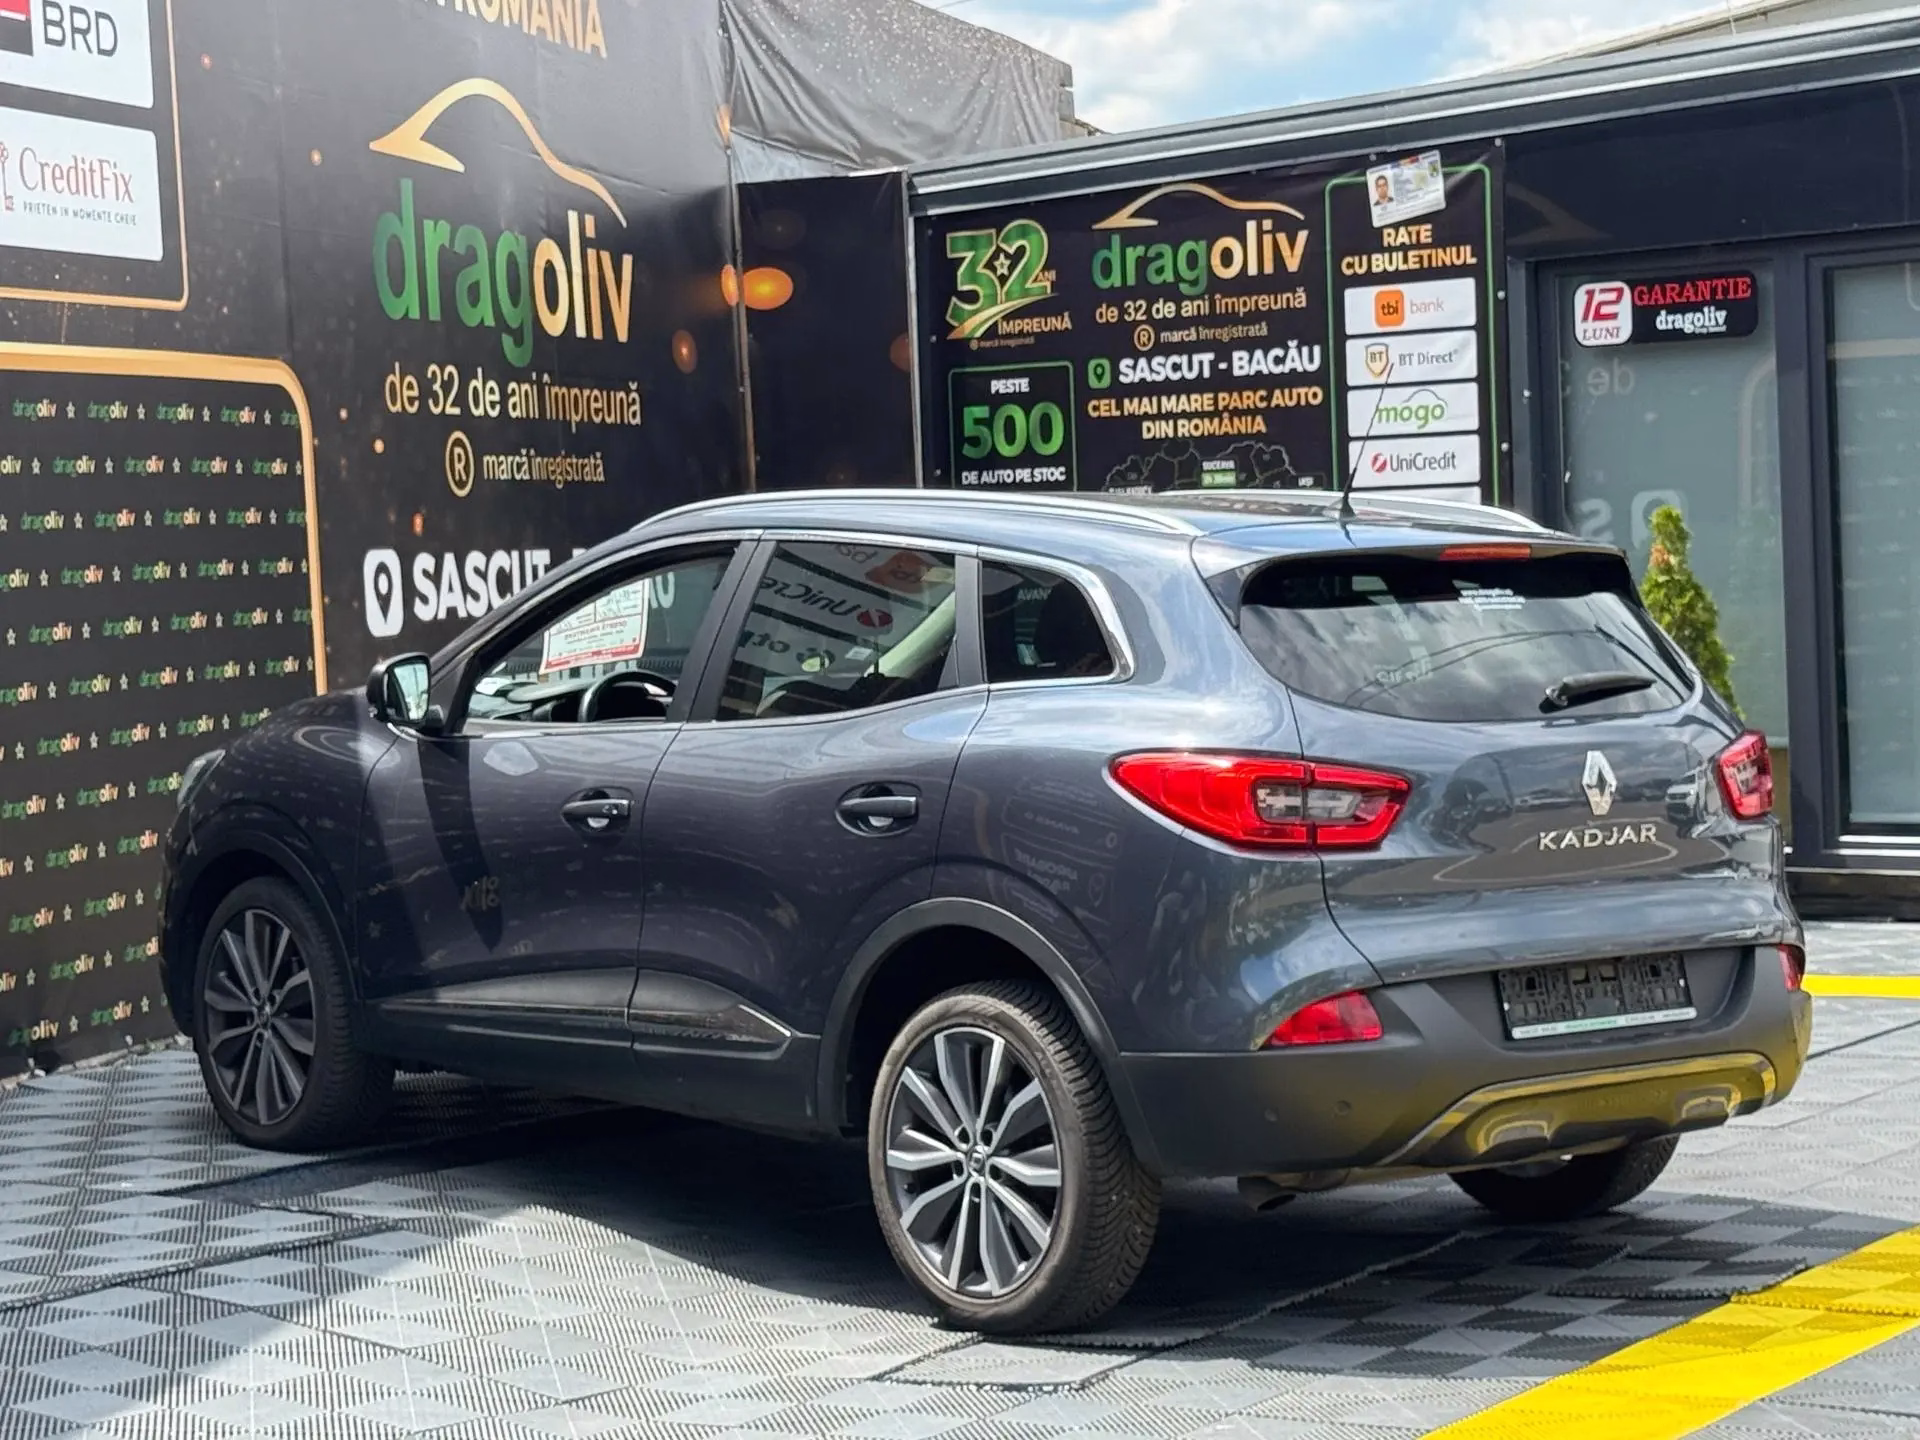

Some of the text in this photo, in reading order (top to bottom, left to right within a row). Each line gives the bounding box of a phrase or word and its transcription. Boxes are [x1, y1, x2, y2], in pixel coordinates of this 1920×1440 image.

[42, 0, 118, 57] BRD
[19, 147, 134, 203] CreditFix
[1382, 223, 1433, 248] RATE
[373, 178, 633, 367] dragoliv
[1091, 219, 1309, 296] dragoliv
[1341, 245, 1477, 276] CU BULETINUL
[1095, 287, 1307, 323] de 32 de ani împreună
[1381, 298, 1445, 317] tbi bank
[1581, 277, 1751, 323] 12 GARANTIE
[1160, 326, 1197, 343] marcă
[1582, 327, 1621, 341] LUNI
[1655, 305, 1727, 334] dragoliv
[1118, 352, 1215, 384] SASCUT
[1231, 340, 1321, 377] BACĂU
[1399, 353, 1414, 366] BT
[1417, 351, 1453, 366] Direct
[385, 361, 642, 433] de 32 de ani împreună
[990, 377, 1030, 394] PESTE
[1087, 386, 1323, 418] CEL MAI MARE PARC AUTO
[1376, 403, 1445, 430] mogo
[962, 402, 1064, 459] 500
[1142, 412, 1267, 440] DIN ROMÂNIA
[483, 448, 530, 481] marcă
[529, 448, 605, 489] înregistrată
[961, 466, 1066, 485] DE AUTO PE STOC
[1389, 451, 1457, 472] UniCredit
[1538, 823, 1657, 851] KADJAR
